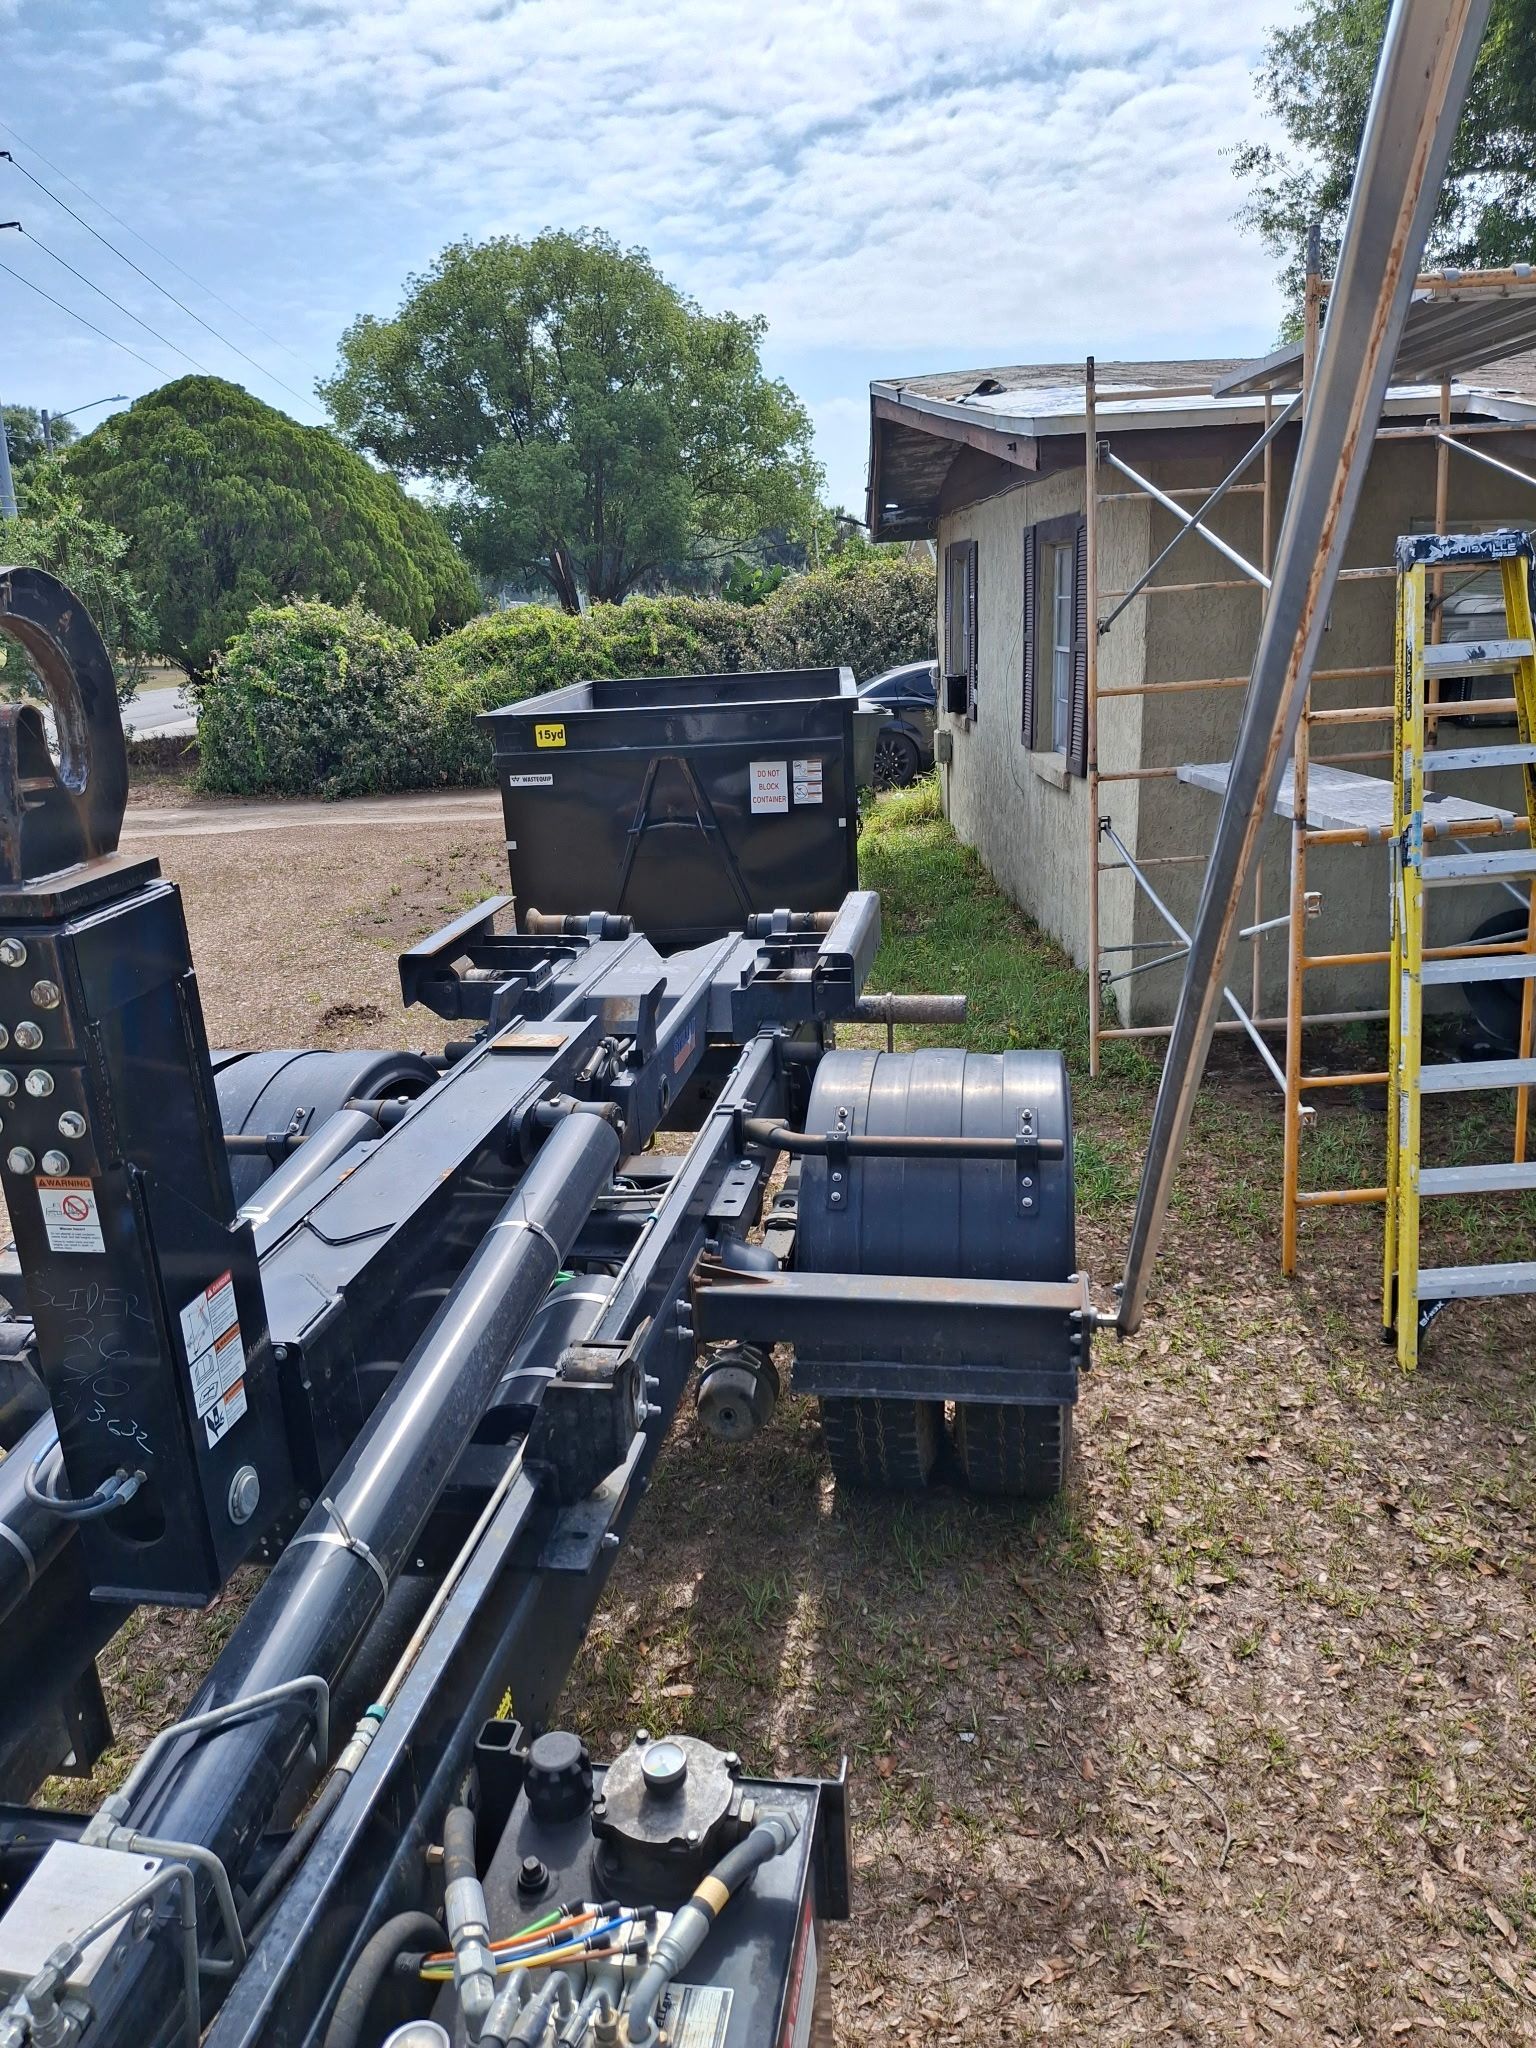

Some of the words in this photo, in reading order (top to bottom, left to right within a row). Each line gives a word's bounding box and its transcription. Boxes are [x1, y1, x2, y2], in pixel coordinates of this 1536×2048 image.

[1441, 541, 1518, 555] OUISVILLE
[538, 729, 564, 741] 15yd
[757, 770, 767, 778] DO
[768, 769, 780, 777] NOT
[758, 783, 780, 791] BLOCK
[752, 795, 787, 804] CONTAINER
[47, 1179, 91, 1188] WARNING
